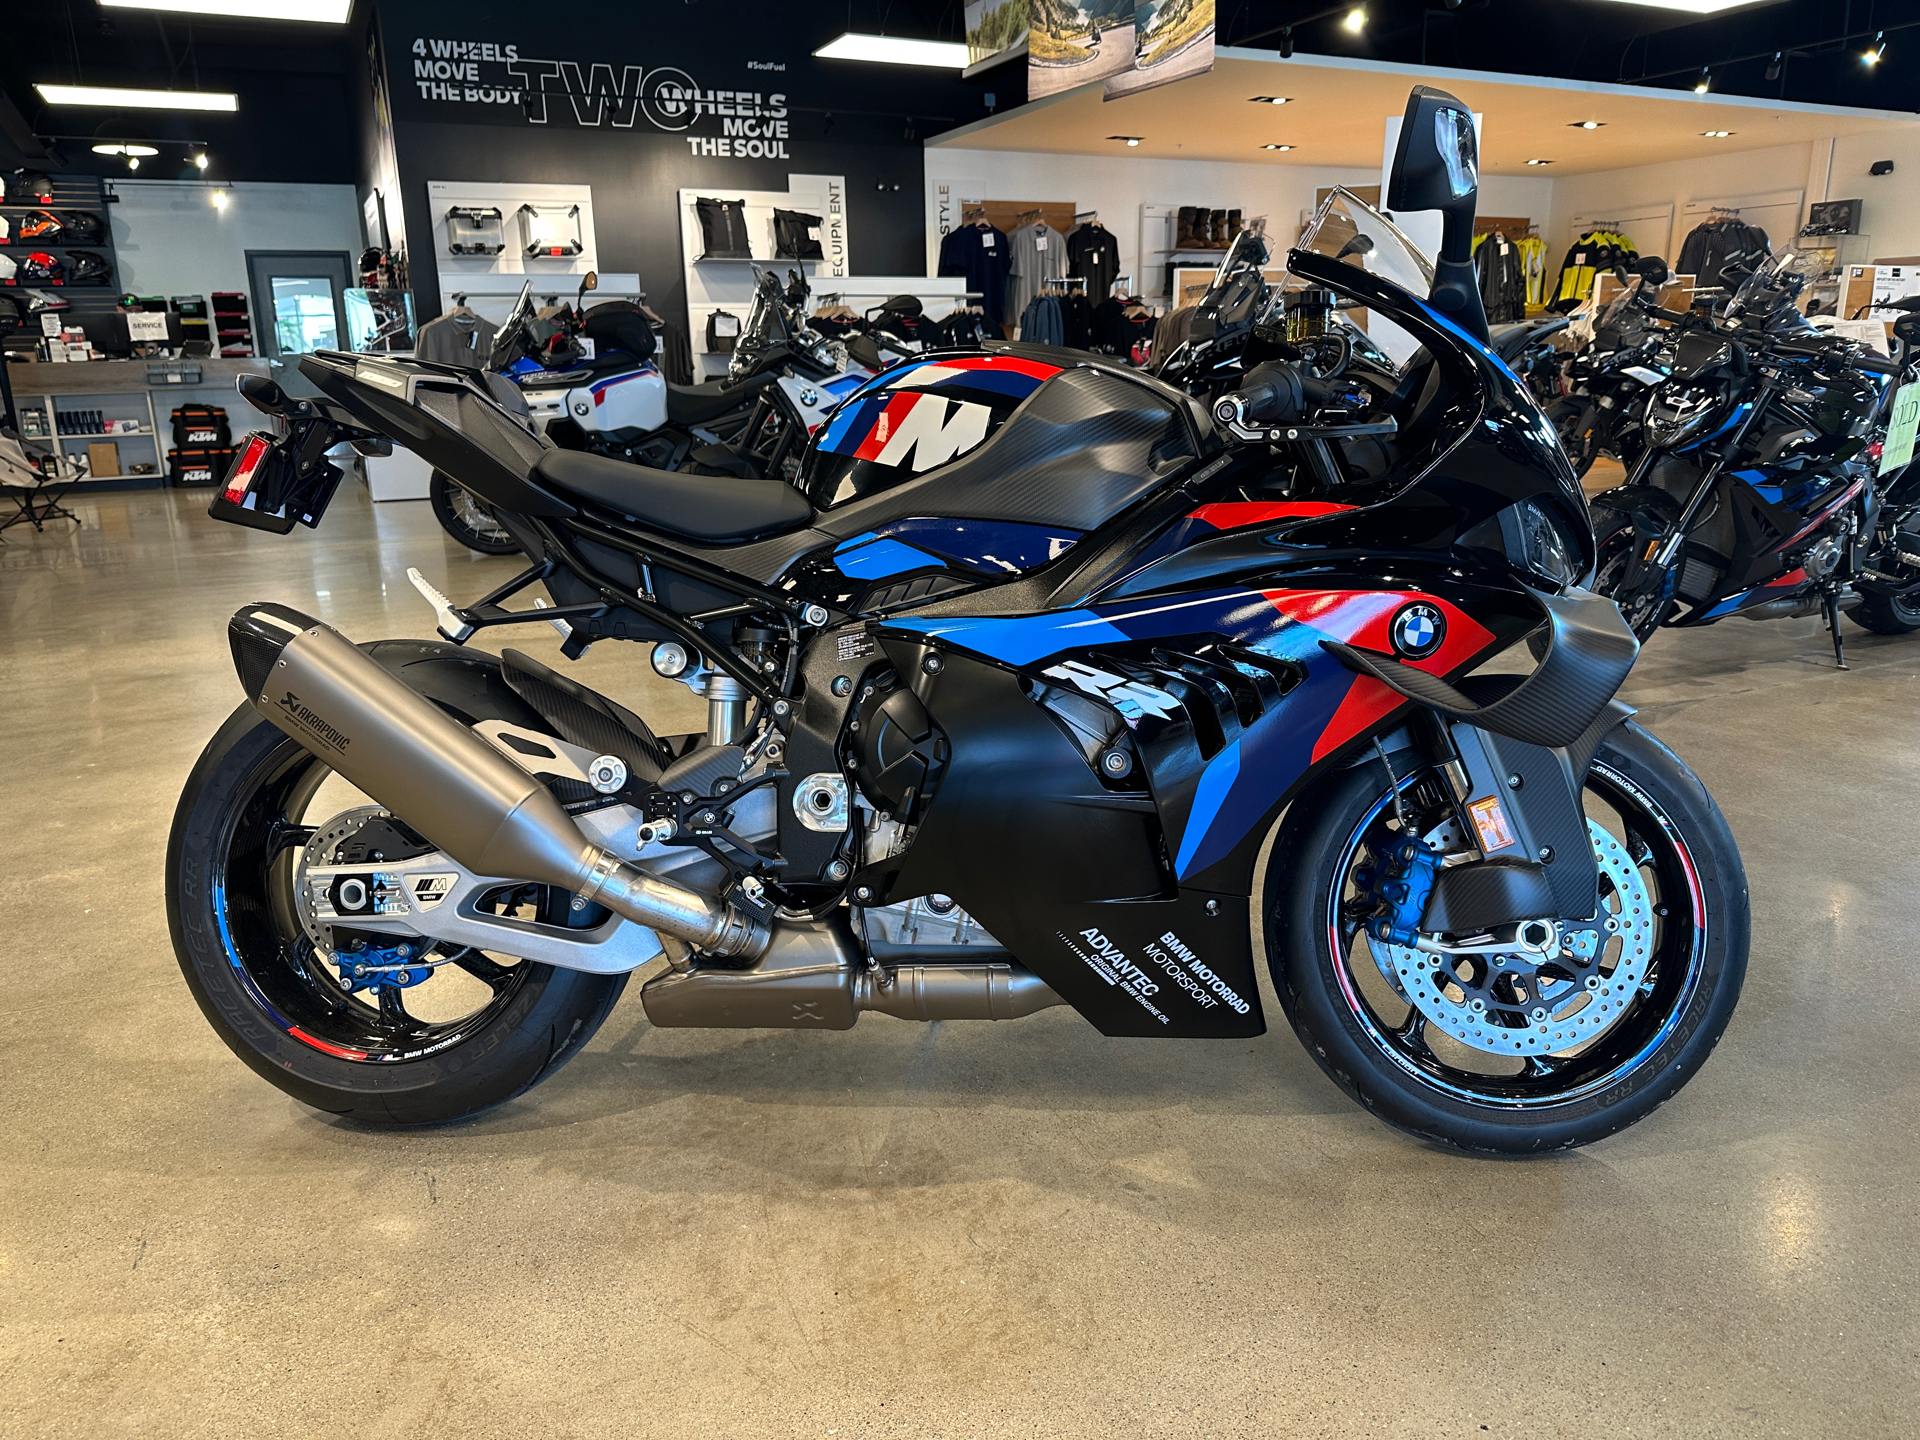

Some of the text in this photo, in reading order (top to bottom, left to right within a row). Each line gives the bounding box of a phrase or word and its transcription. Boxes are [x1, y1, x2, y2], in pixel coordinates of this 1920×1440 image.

[412, 38, 519, 63] 4 WHEELS
[414, 59, 480, 82] MOVE
[747, 61, 786, 72] #SoulFuel
[416, 81, 523, 105] THE BODY
[507, 57, 701, 132] TWO
[660, 87, 788, 119] WHEELS
[723, 117, 790, 139] MOVE
[686, 136, 790, 160] THE SOUL
[938, 185, 951, 236] STYLE
[132, 321, 164, 330] SERVICE
[1890, 400, 1919, 431] SOLD
[187, 431, 218, 442] KTM
[182, 470, 212, 481] KTM
[284, 715, 331, 751] BMW MOTORRAD
[1596, 764, 1654, 809] BMW MOTORRAD
[1079, 926, 1160, 997] ADVANTEC
[1159, 930, 1251, 1016] BMW MOTORRAD
[1090, 953, 1171, 1025] ORIGINAL BMW ENGINE OIL
[1142, 942, 1219, 1010] MOTORSPORT
[403, 1048, 423, 1059] BMW
[423, 1033, 462, 1055] MOTORRAD
